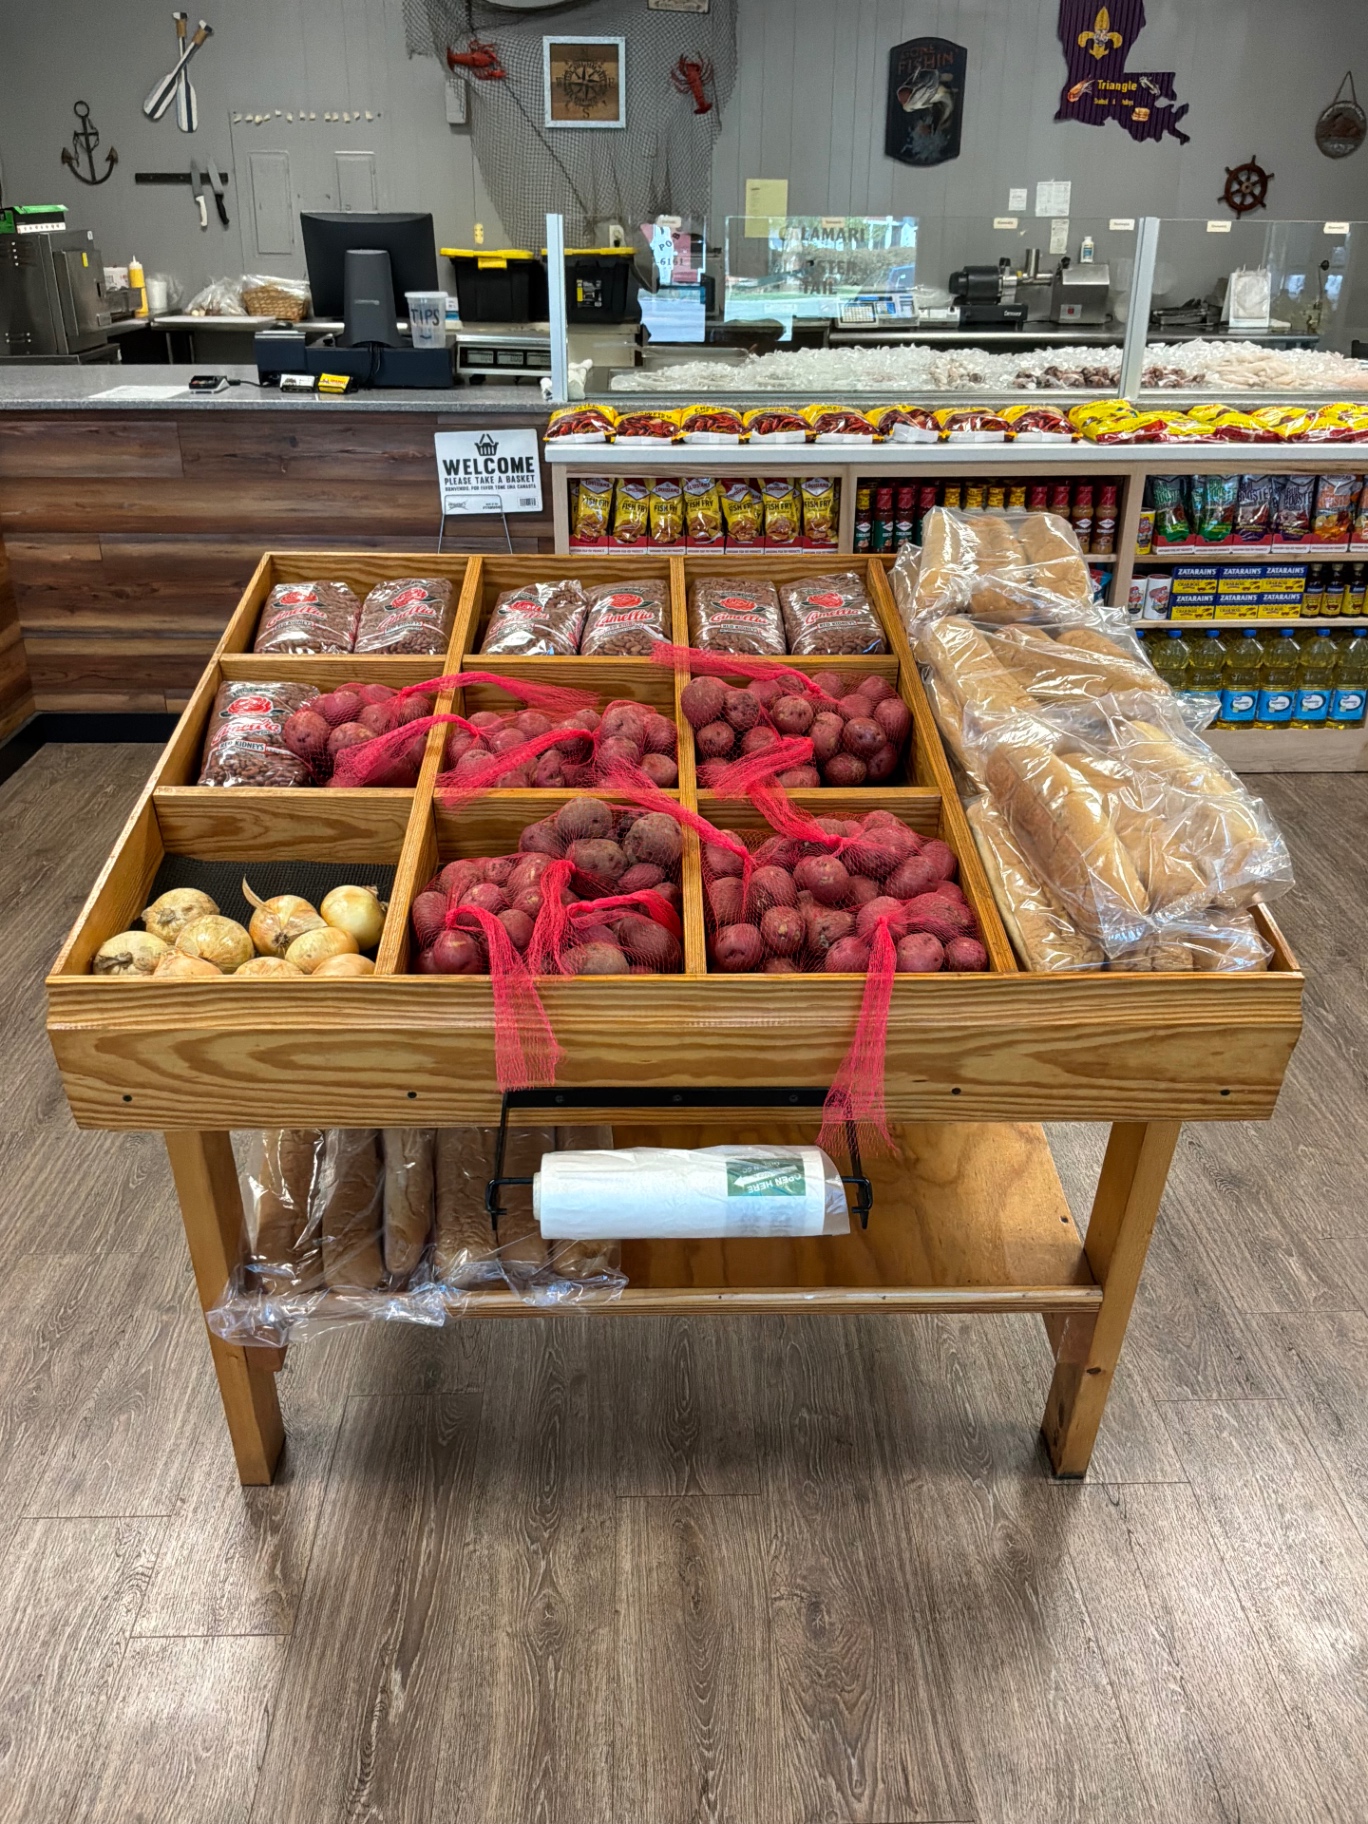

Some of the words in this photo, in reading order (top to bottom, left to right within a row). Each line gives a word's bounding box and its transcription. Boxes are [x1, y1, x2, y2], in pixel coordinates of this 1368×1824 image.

[1098, 80, 1137, 92] Triangle
[779, 226, 865, 243] CLAMARI
[411, 308, 440, 327] TIPS
[442, 456, 535, 476] WELCOME
[444, 477, 472, 486] PLEASE
[475, 476, 494, 484] TAKE
[498, 475, 503, 483] A
[506, 474, 535, 483] BASKET
[622, 503, 636, 511] FISH
[266, 606, 327, 628] Camellia
[594, 610, 654, 628] Camellia
[710, 612, 768, 623] Camellia
[805, 609, 860, 624] Camellia
[235, 740, 265, 751] KIDNEYS
[747, 1179, 773, 1193] HERE
[775, 1173, 802, 1186] OPEN
